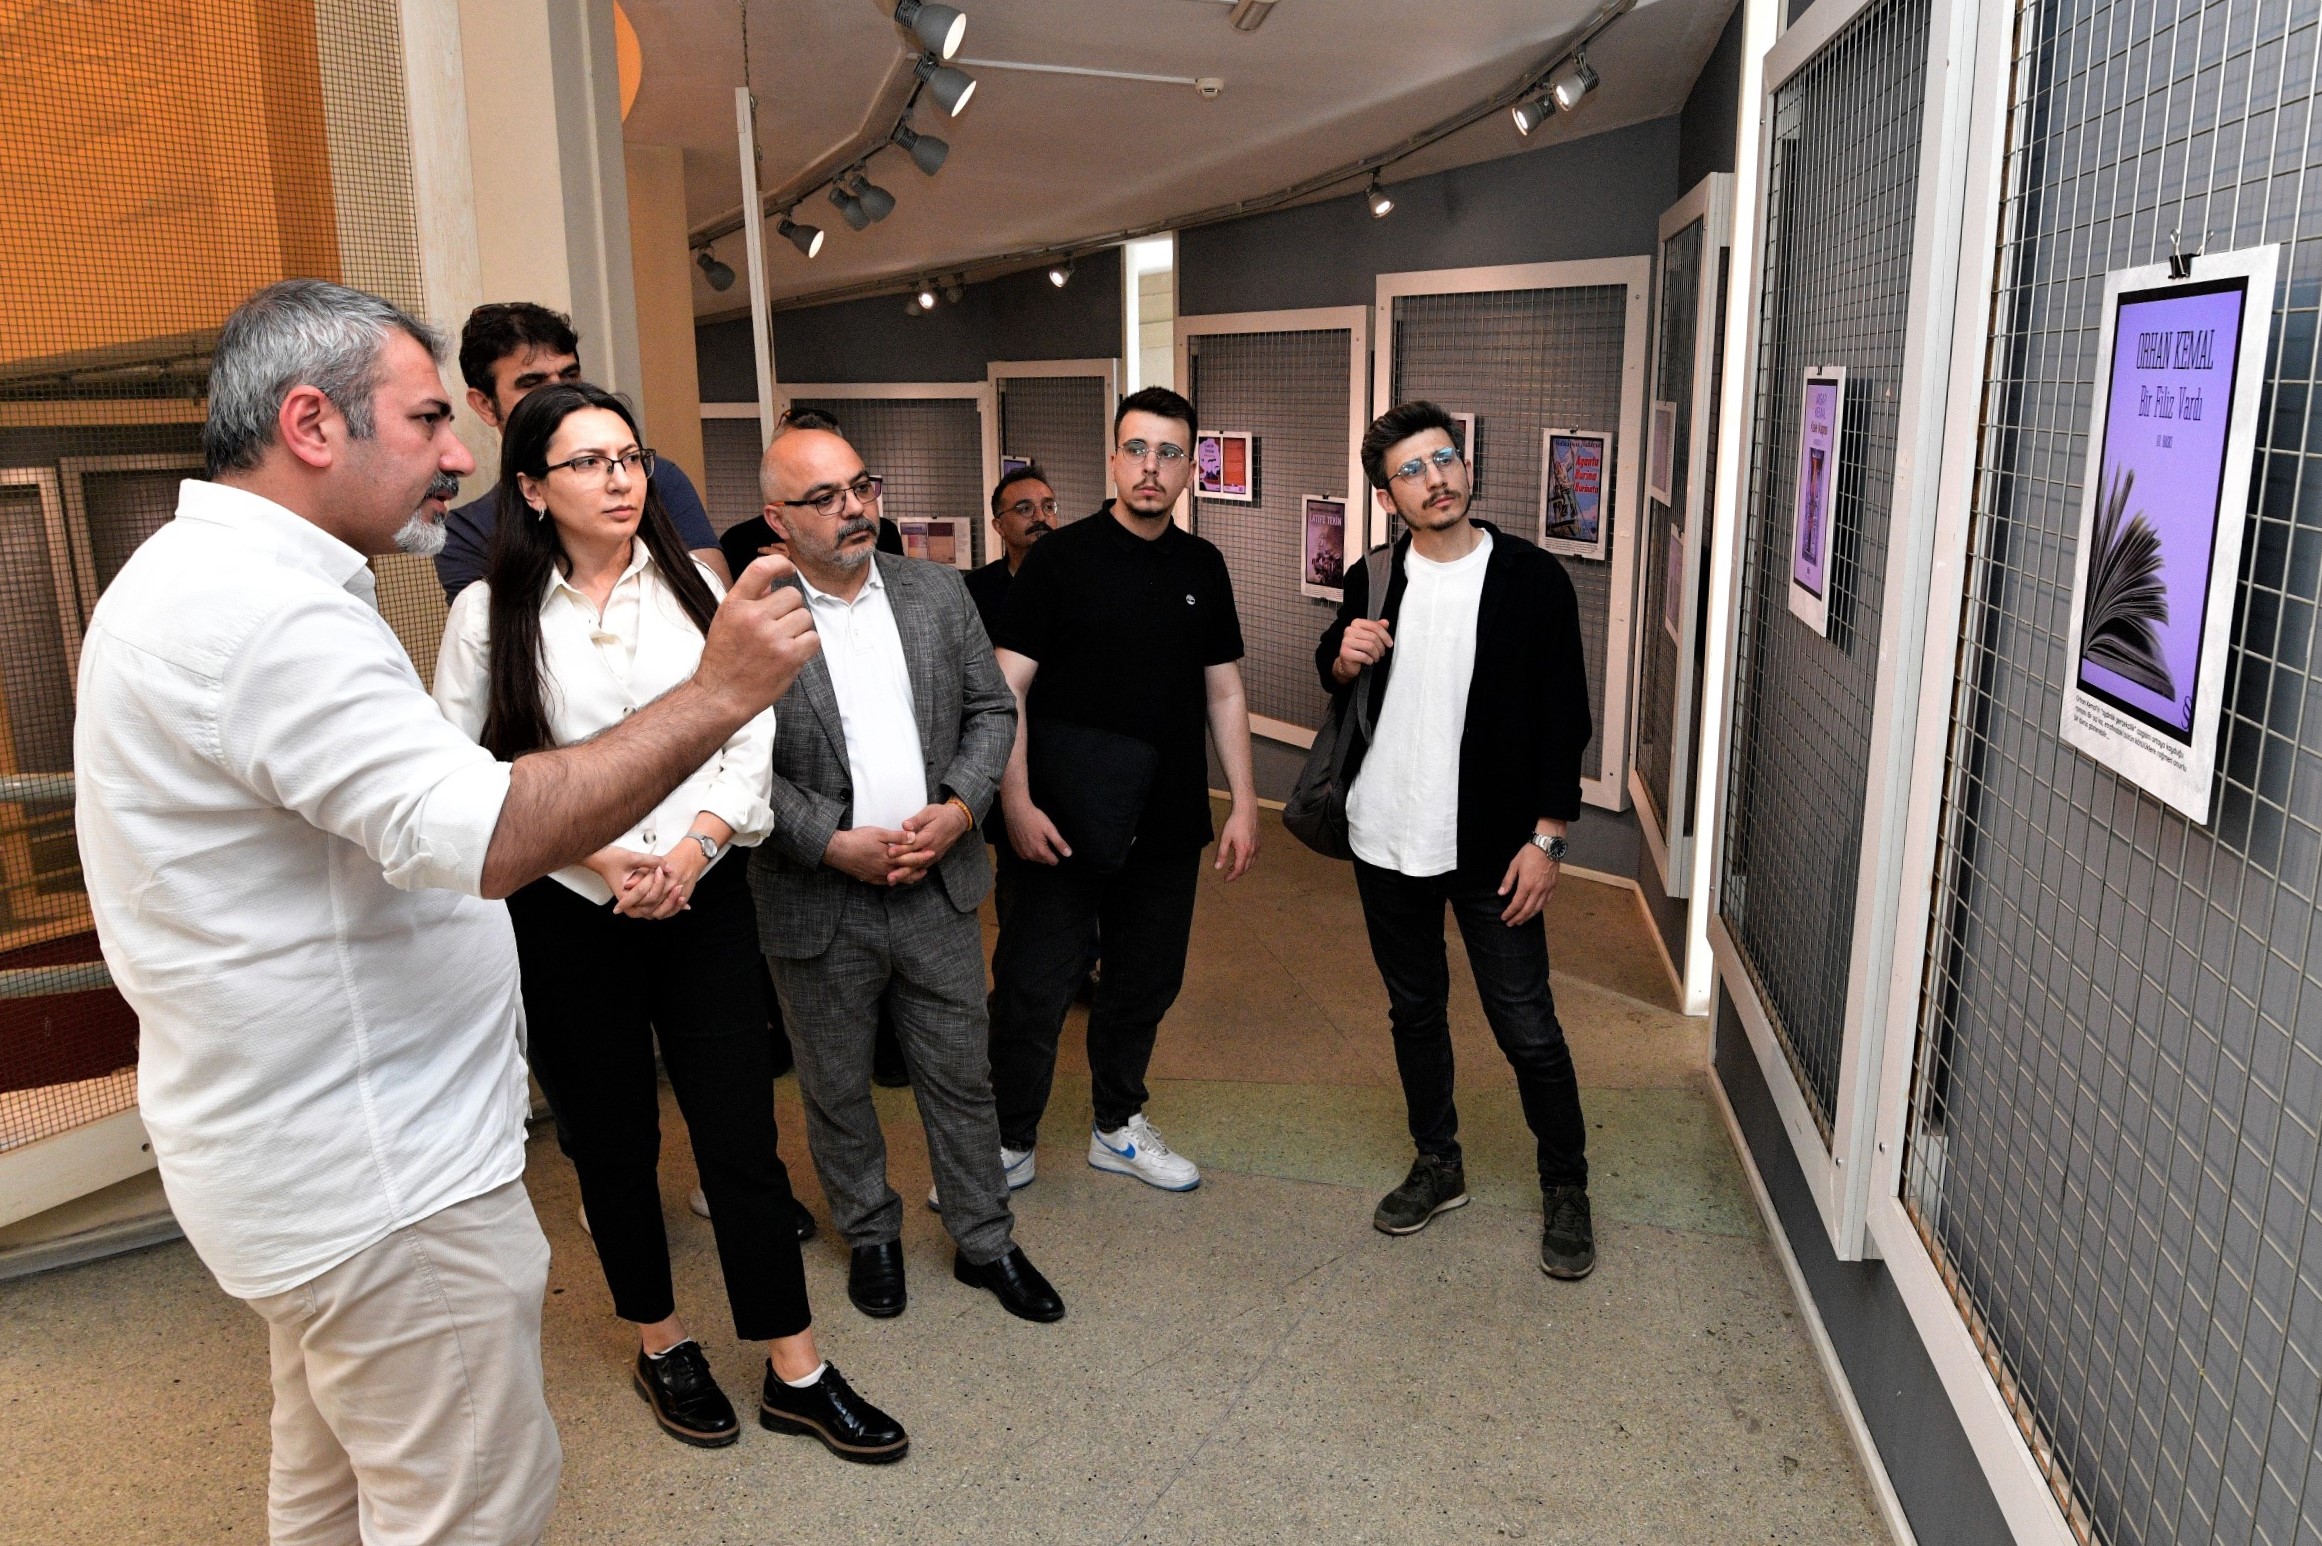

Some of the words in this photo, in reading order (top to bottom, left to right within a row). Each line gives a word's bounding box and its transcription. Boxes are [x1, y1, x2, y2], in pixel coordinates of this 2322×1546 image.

[2136, 331, 2173, 369] ORHAN
[2173, 329, 2215, 369] KEMAL
[2138, 385, 2153, 417] Bir
[2153, 386, 2175, 419] Filiz
[2179, 387, 2203, 421] Vardı
